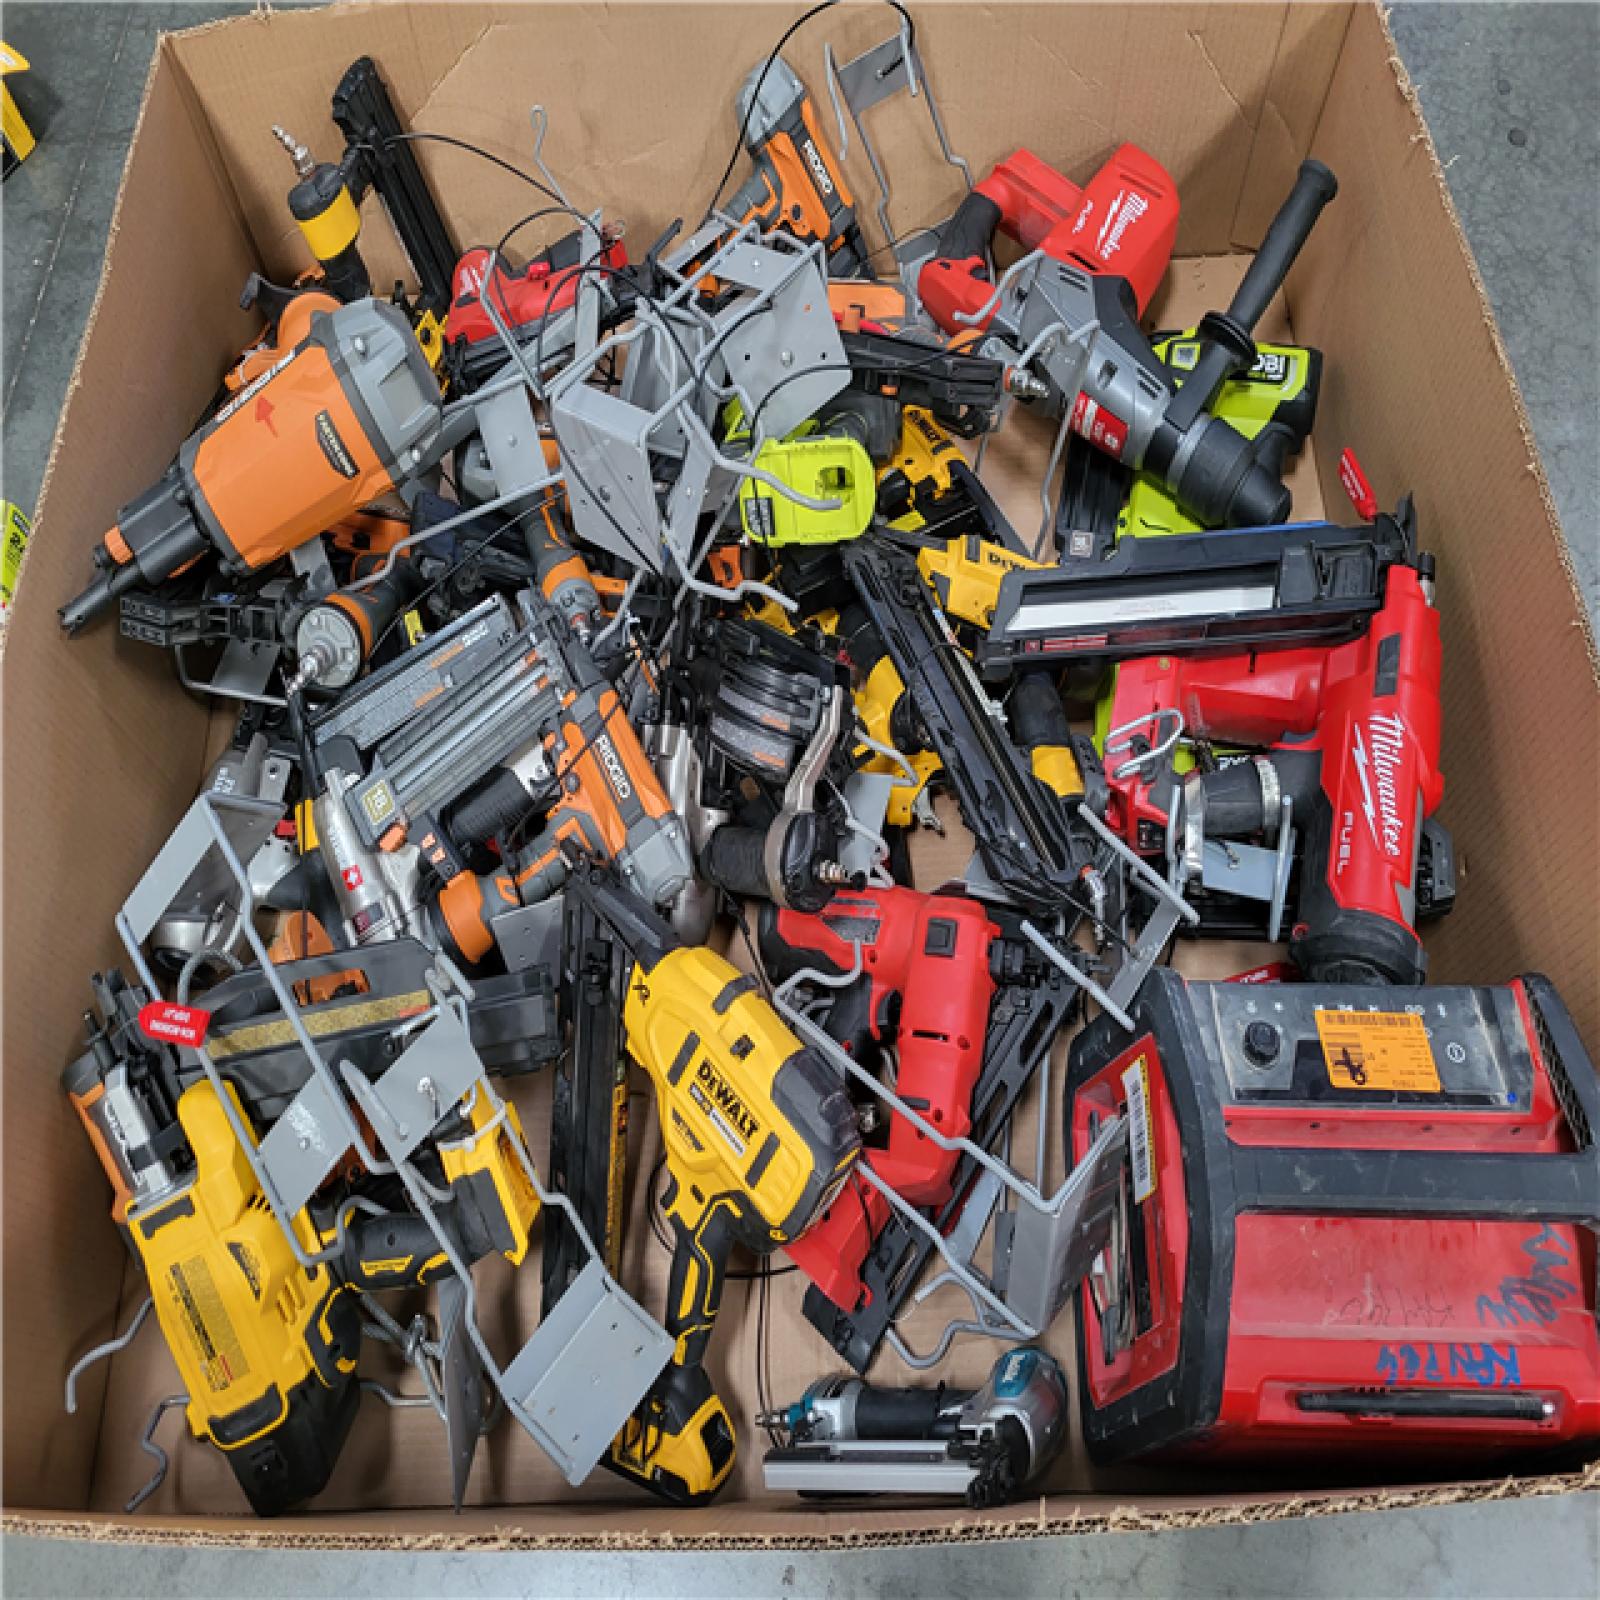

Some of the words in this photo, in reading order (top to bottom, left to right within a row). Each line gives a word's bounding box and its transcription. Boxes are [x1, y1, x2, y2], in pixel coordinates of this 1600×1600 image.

[595, 734, 631, 799] RIDGID
[1368, 712, 1405, 856] Milwaukee
[1337, 812, 1353, 876] FUEL
[695, 1057, 760, 1143] DEWALT
